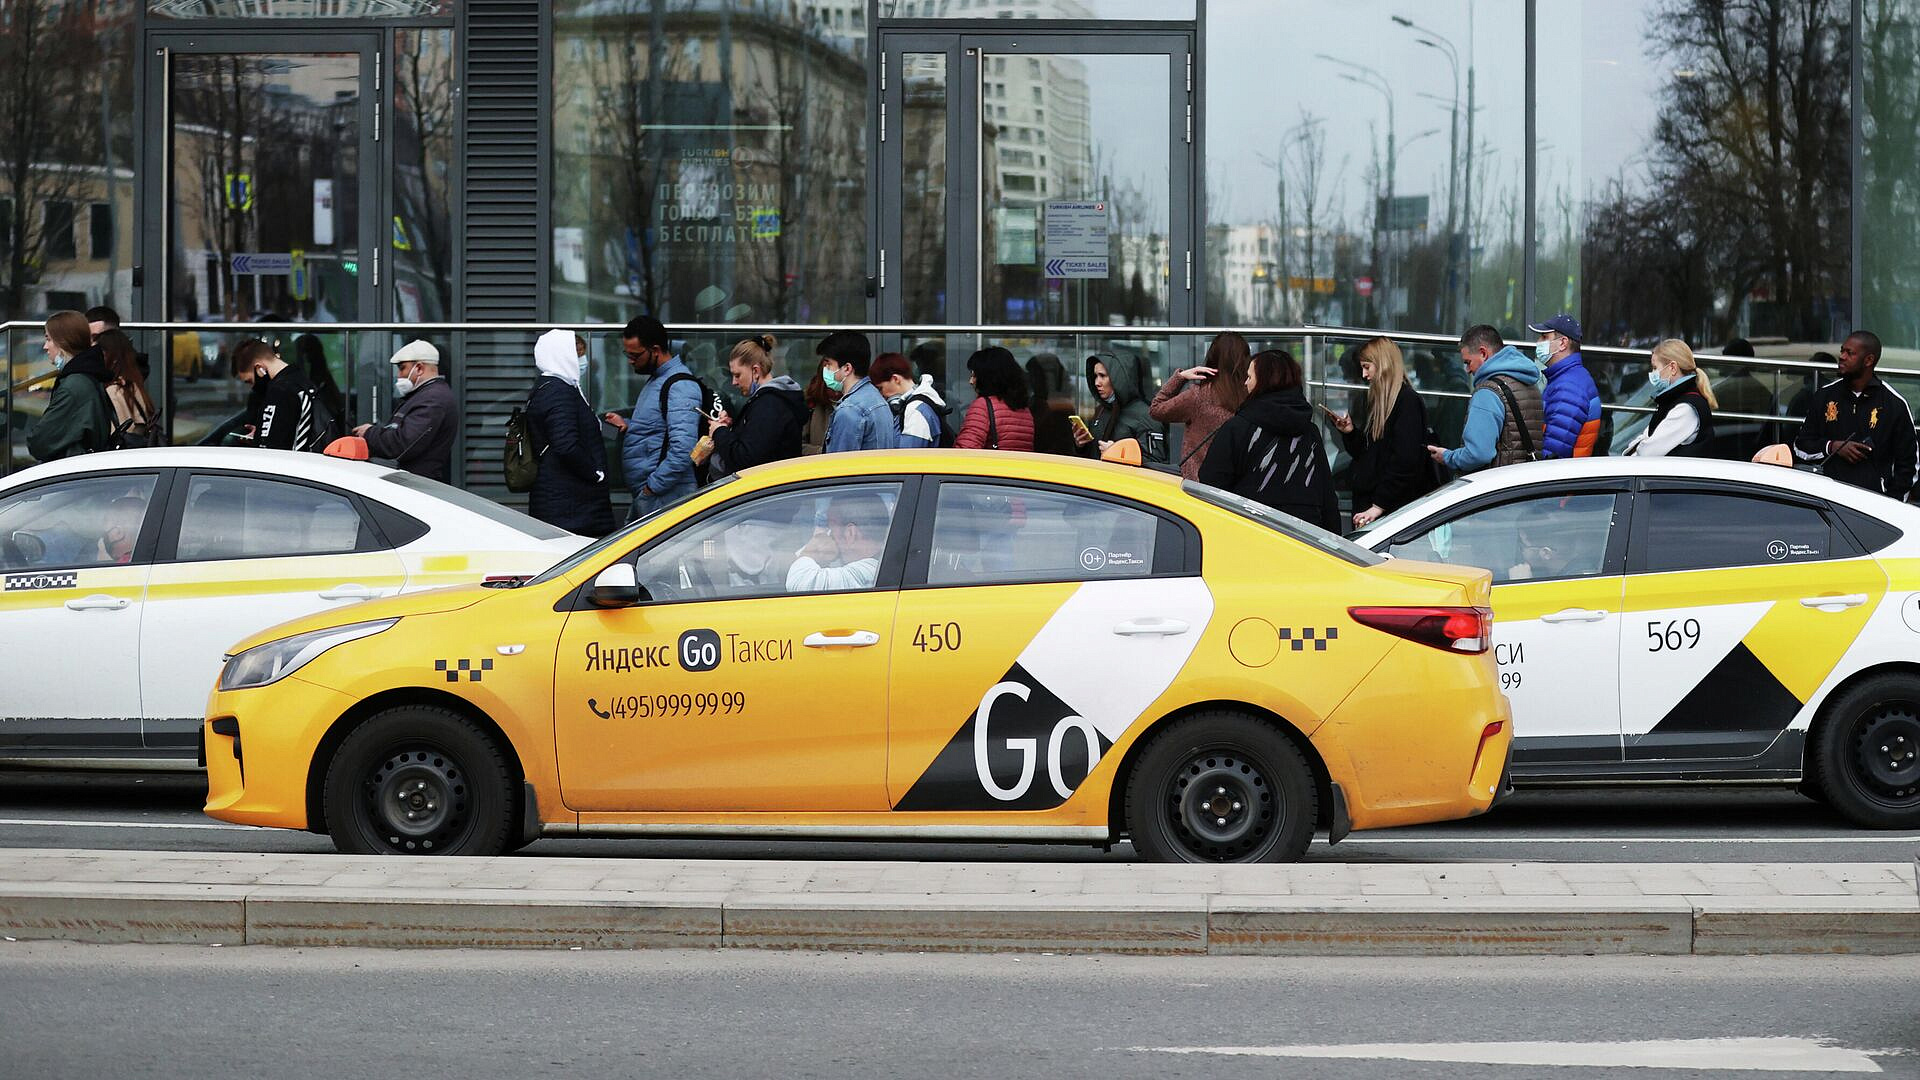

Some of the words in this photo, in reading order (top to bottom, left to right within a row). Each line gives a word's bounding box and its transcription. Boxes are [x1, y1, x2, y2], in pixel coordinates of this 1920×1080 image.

[912, 621, 962, 652] 450
[1647, 618, 1701, 652] 569
[585, 641, 671, 673] Яндекс
[682, 635, 717, 667] Go
[726, 633, 793, 663] Такси
[1501, 672, 1522, 689] 99
[974, 681, 1101, 801] Go
